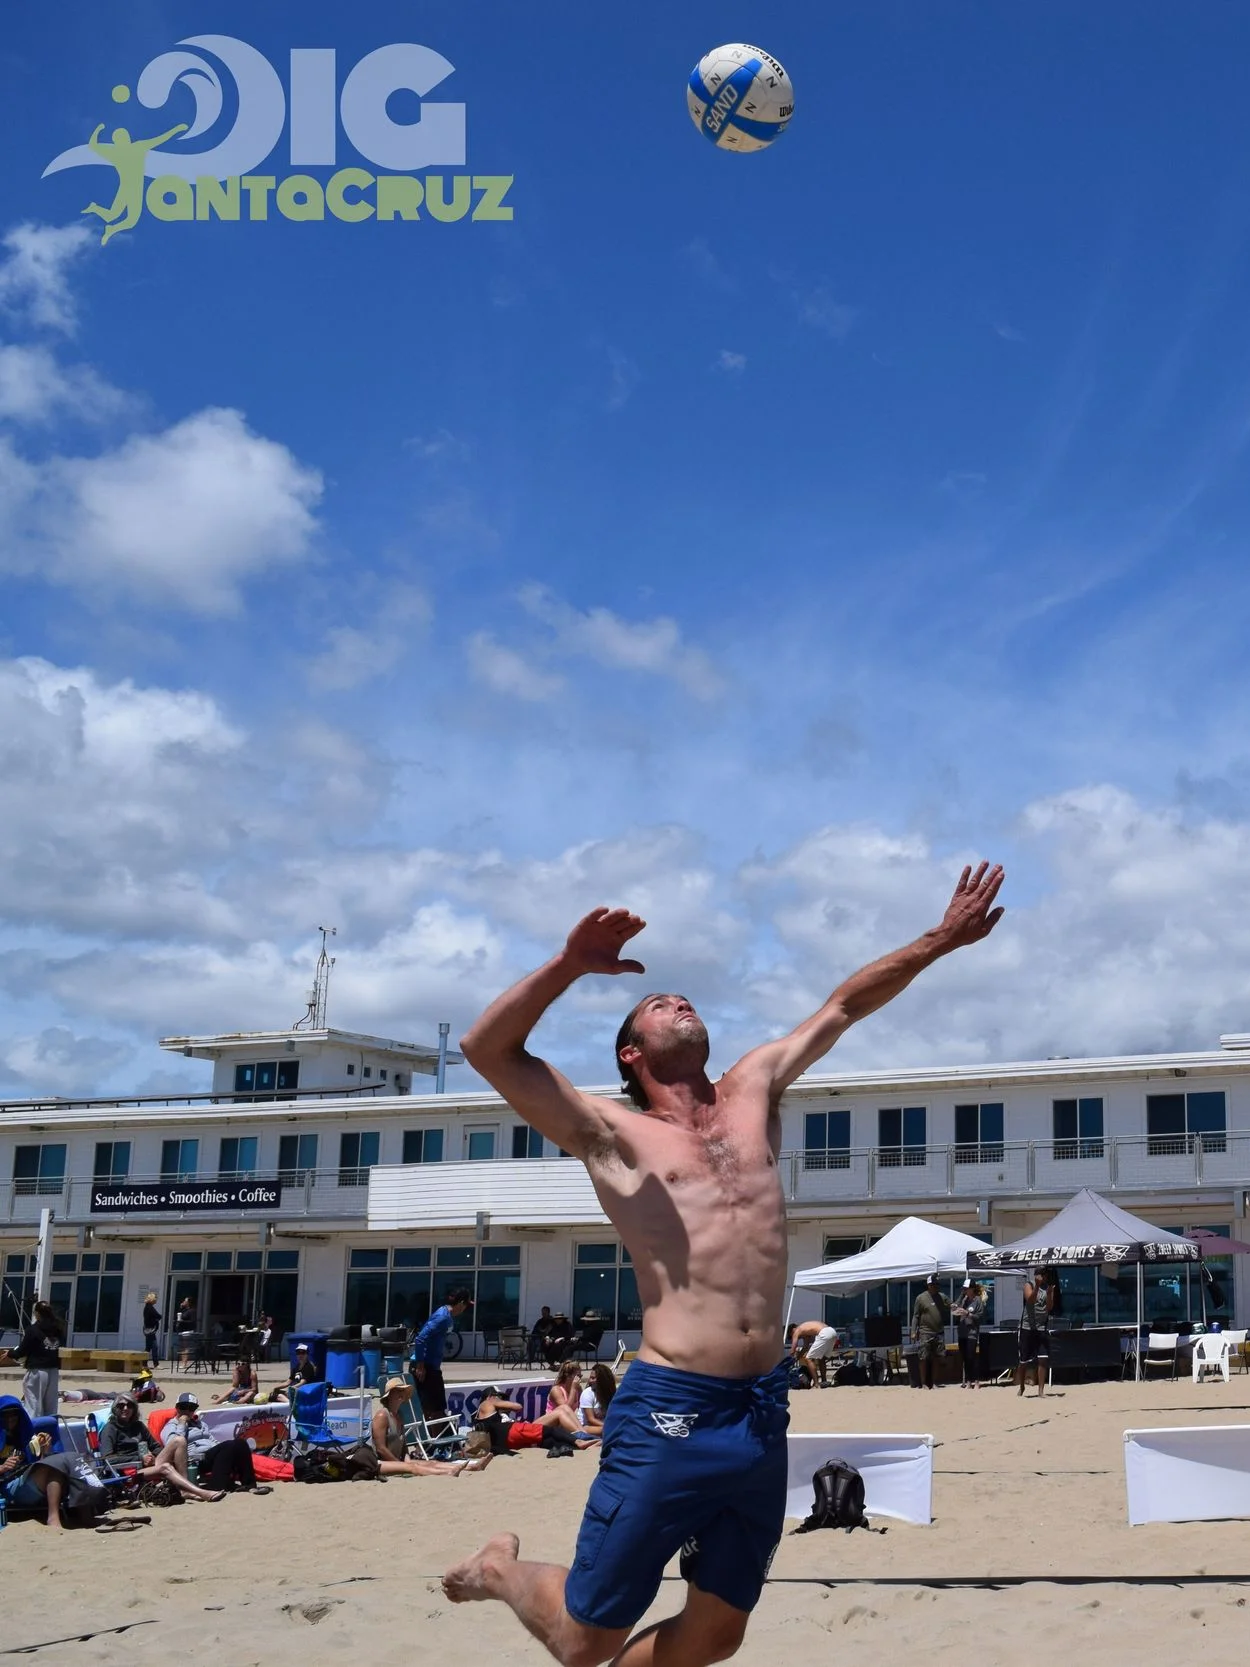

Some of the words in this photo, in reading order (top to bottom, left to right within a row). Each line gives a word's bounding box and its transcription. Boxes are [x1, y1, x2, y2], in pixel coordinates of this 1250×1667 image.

[706, 84, 738, 133] SAND
[95, 1192, 158, 1206] Sandwiches
[169, 1189, 228, 1204] Smoothies
[238, 1187, 277, 1203] Coffee
[1052, 1245, 1097, 1259] SPORTS
